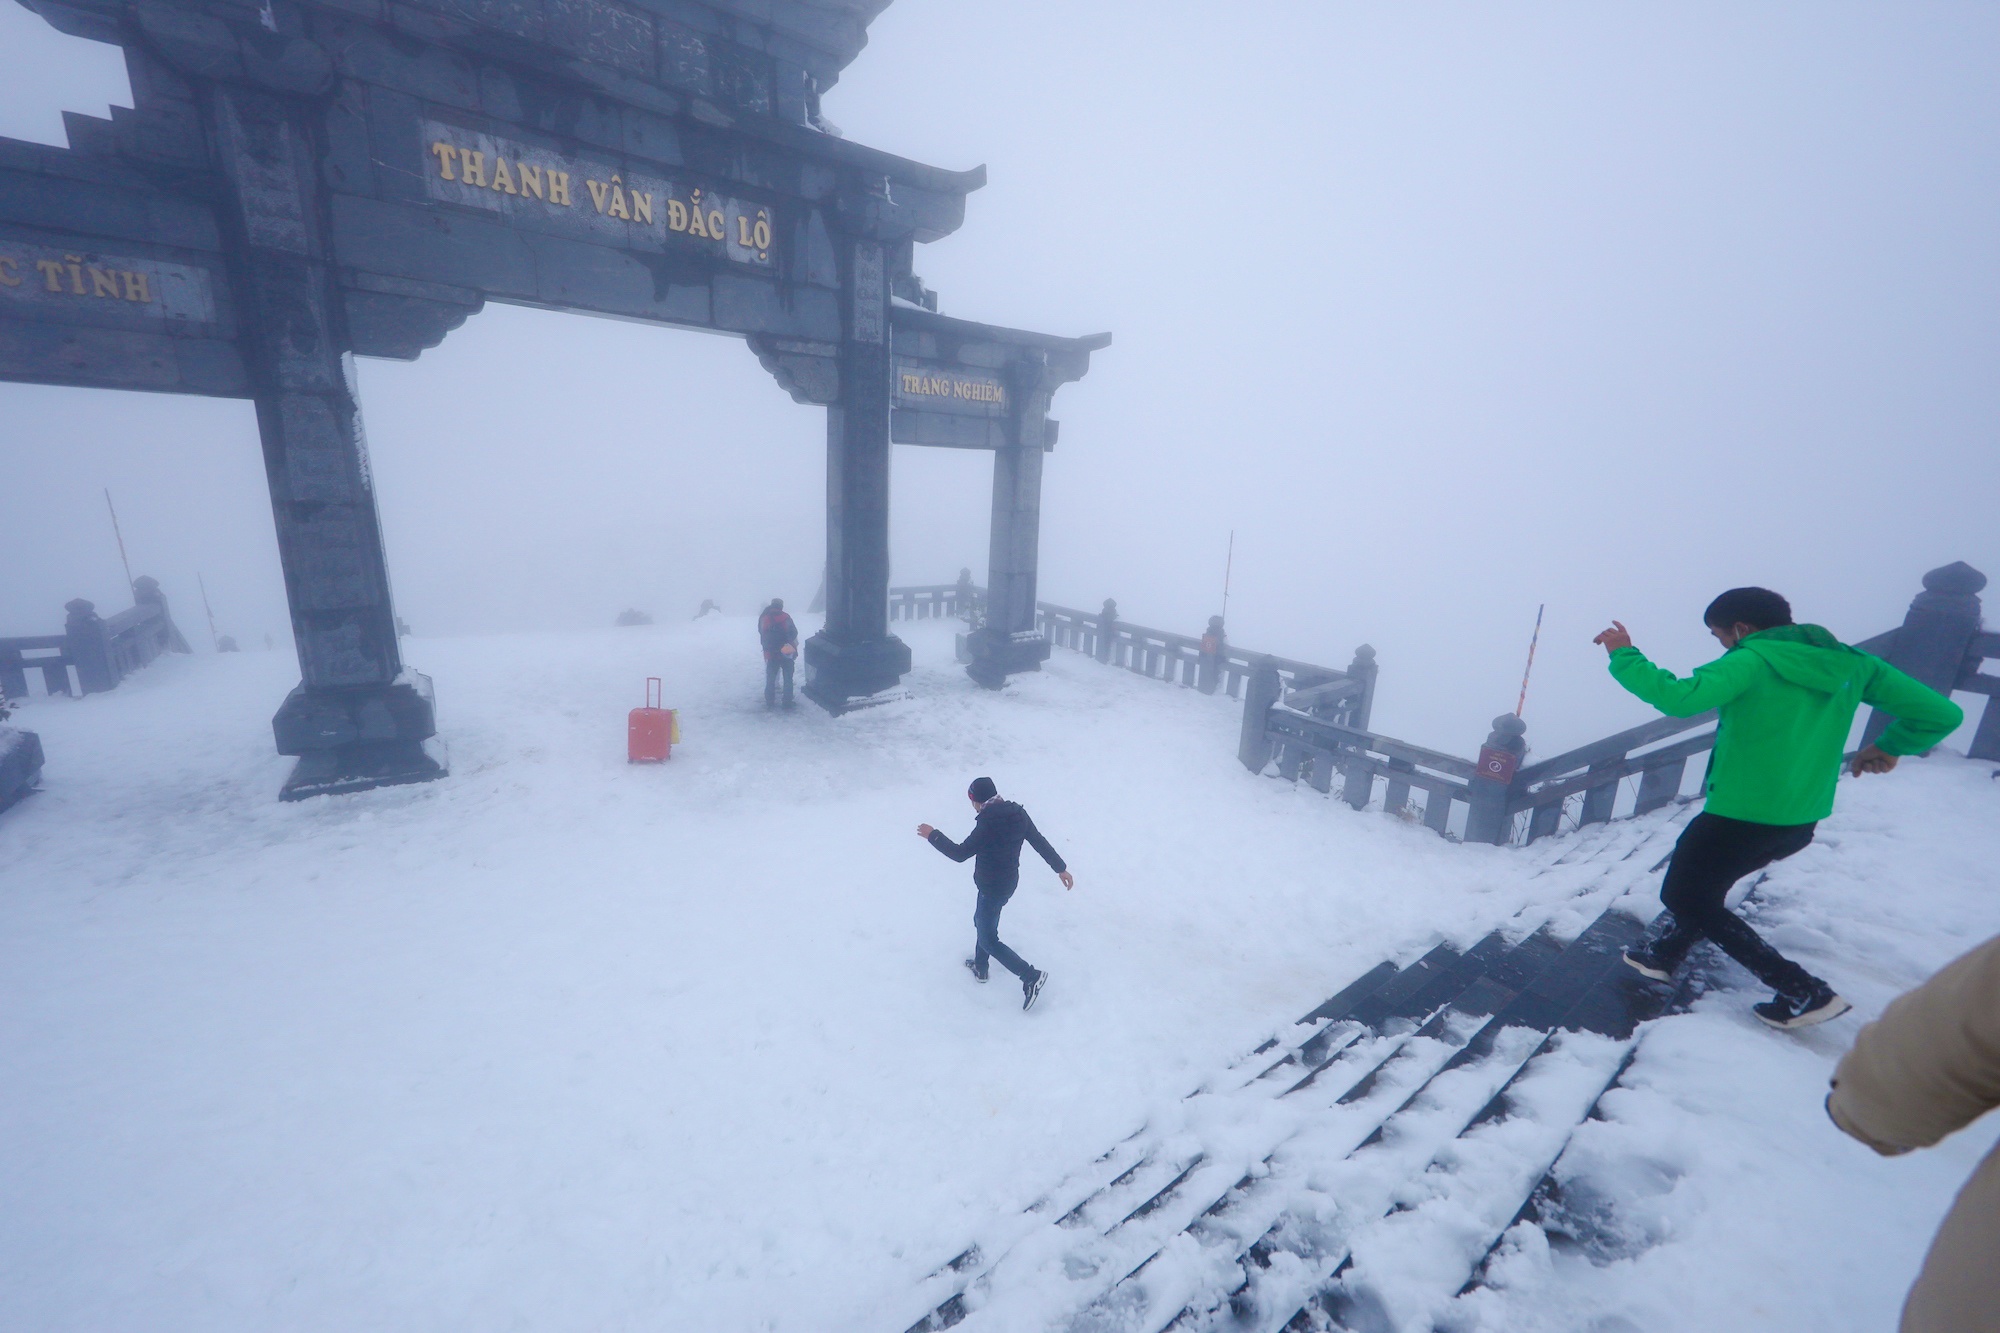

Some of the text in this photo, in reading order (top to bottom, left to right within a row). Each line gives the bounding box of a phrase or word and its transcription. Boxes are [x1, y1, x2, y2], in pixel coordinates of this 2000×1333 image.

[432, 141, 771, 259] THANH VÂN ĐẮC LỘ
[36, 253, 152, 303] TĨNH
[902, 374, 1003, 403] TRANG NGHIÊM
